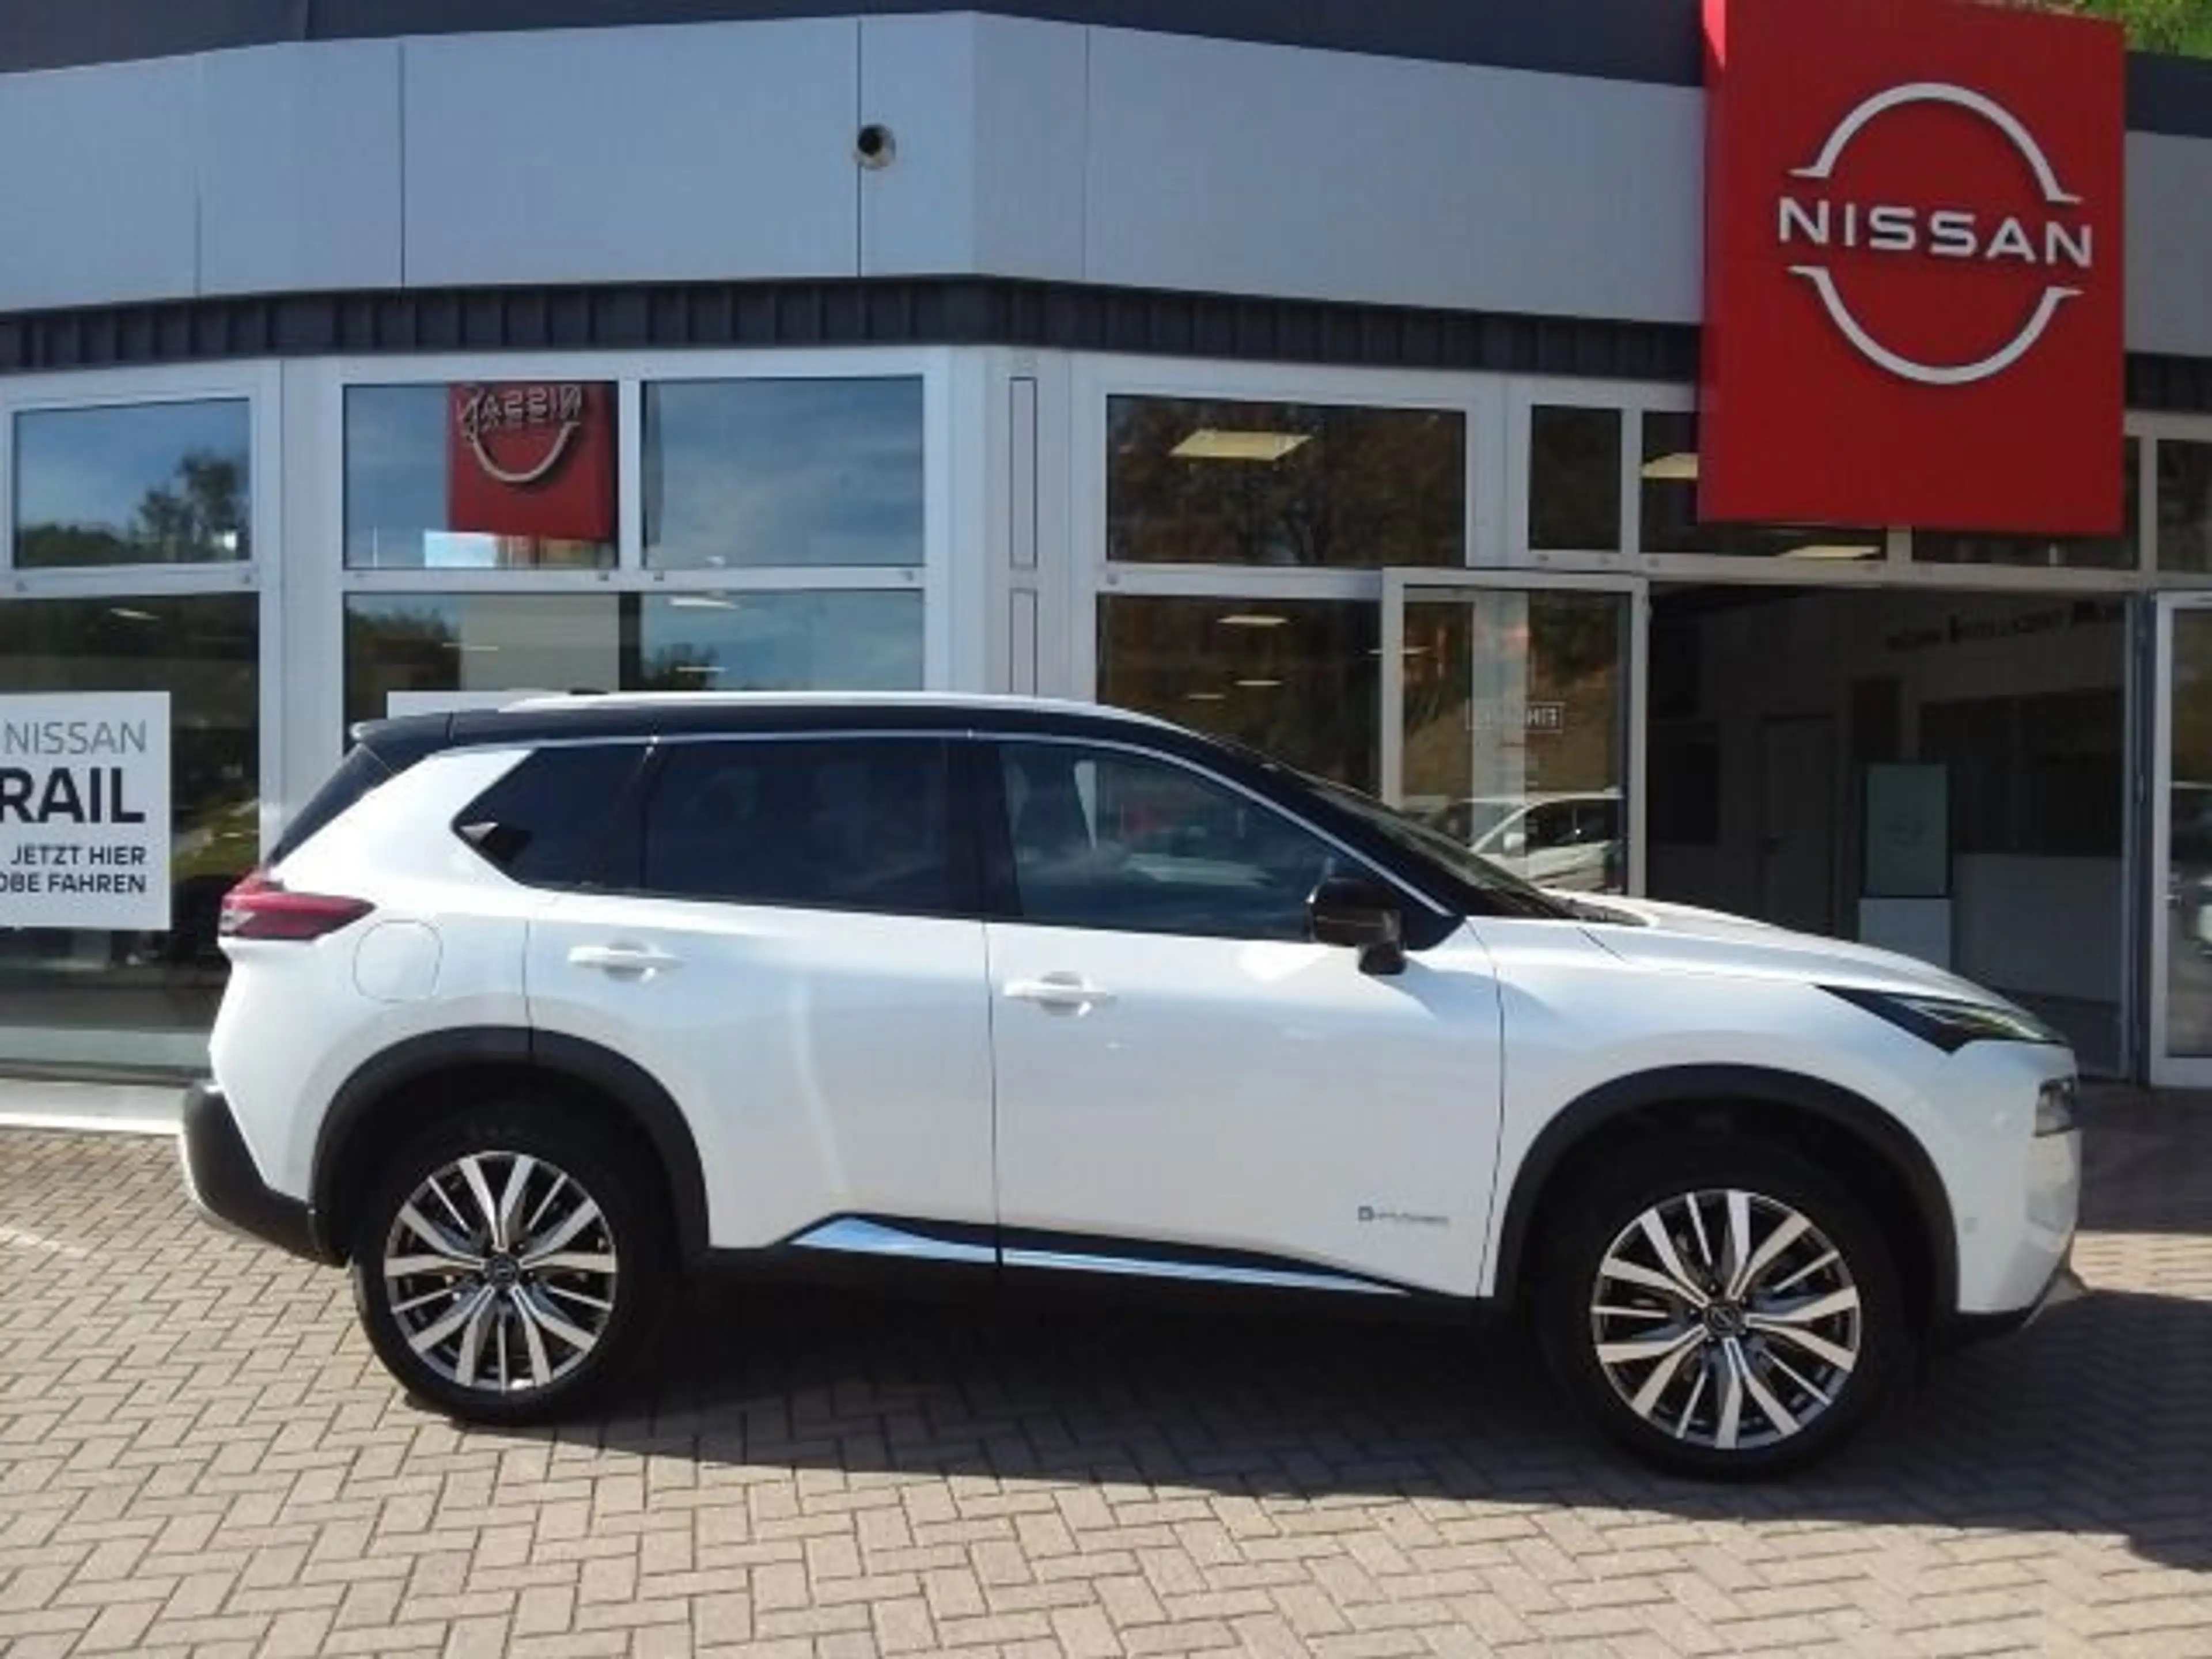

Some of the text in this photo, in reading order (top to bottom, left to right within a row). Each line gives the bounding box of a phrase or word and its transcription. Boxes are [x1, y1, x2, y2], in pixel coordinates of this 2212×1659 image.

[1779, 196, 2092, 268] NISSAN
[4, 720, 146, 755] NISSAN
[0, 767, 146, 824] RAIL
[11, 846, 147, 865] JETZT HIER
[48, 873, 146, 893] FAHREN
